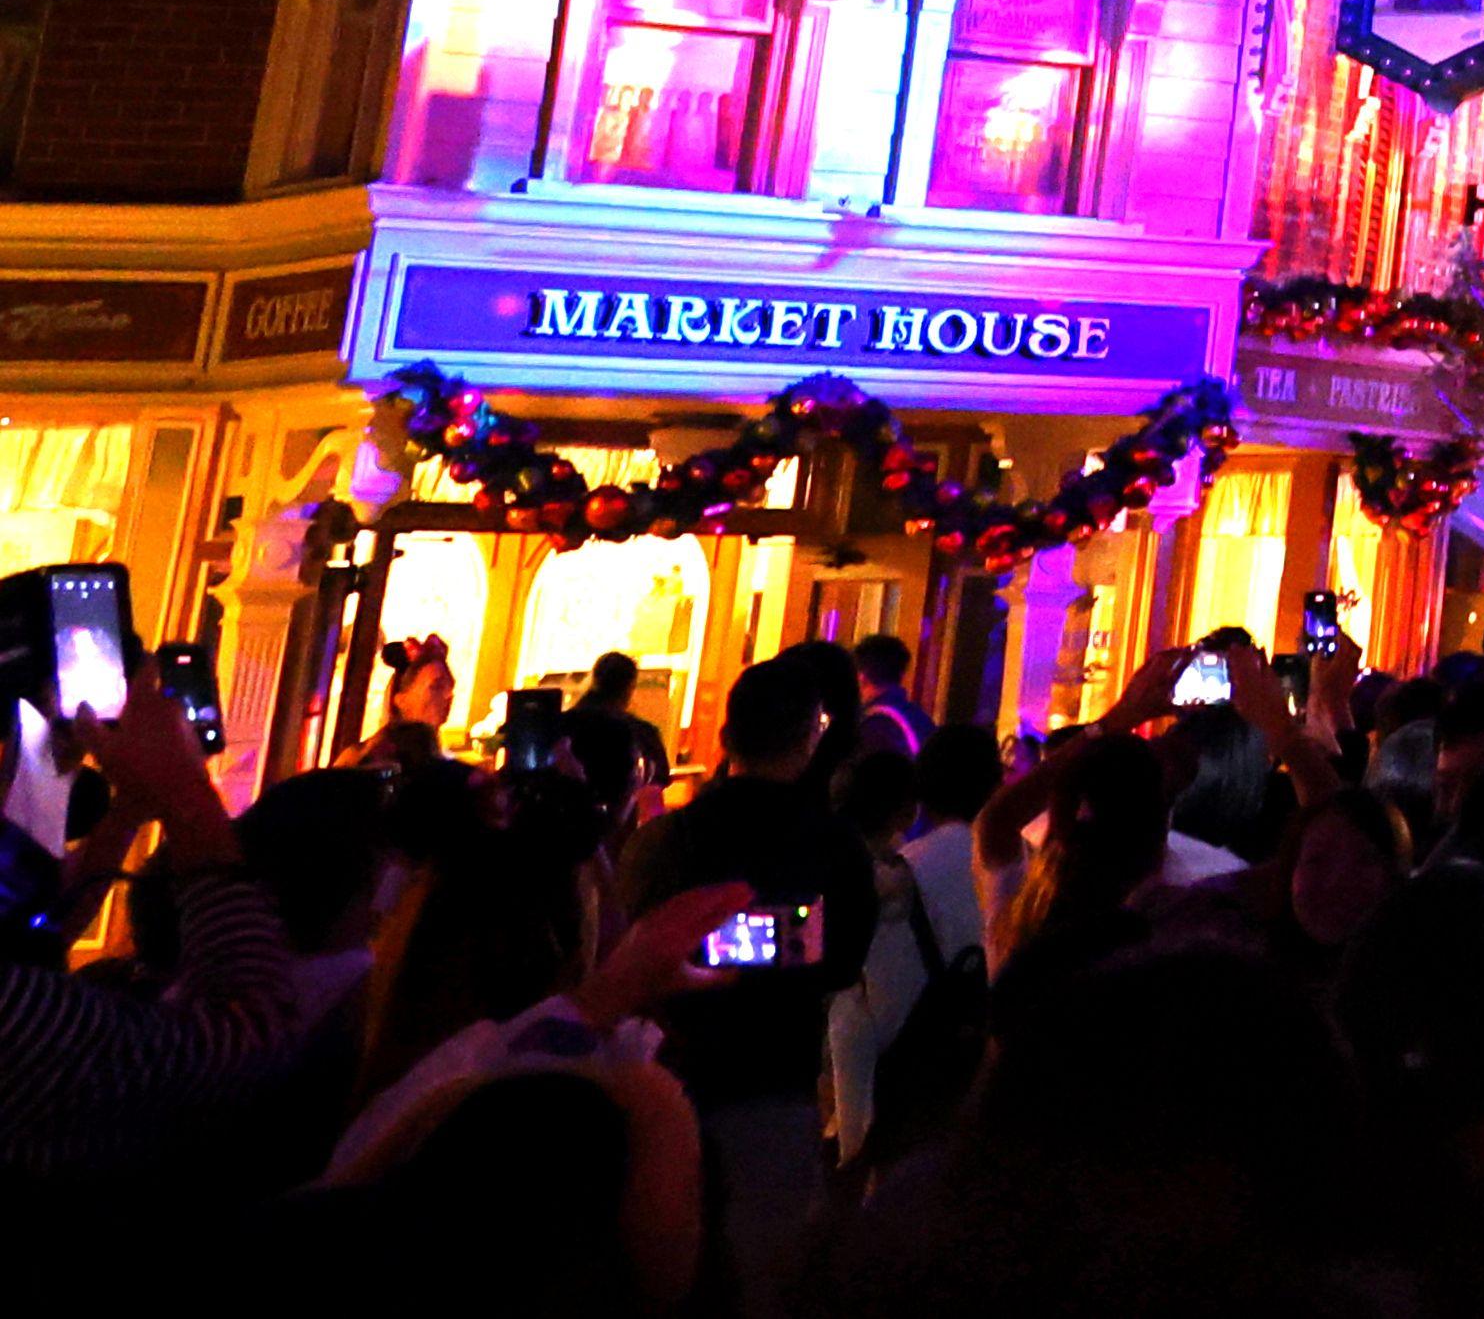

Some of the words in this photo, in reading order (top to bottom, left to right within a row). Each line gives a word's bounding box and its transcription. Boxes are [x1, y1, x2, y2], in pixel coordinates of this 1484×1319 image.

[535, 288, 855, 348] MARKET
[877, 305, 1112, 359] HOUSE
[1255, 366, 1297, 402] TEA
[1328, 375, 1420, 417] PASTRI
